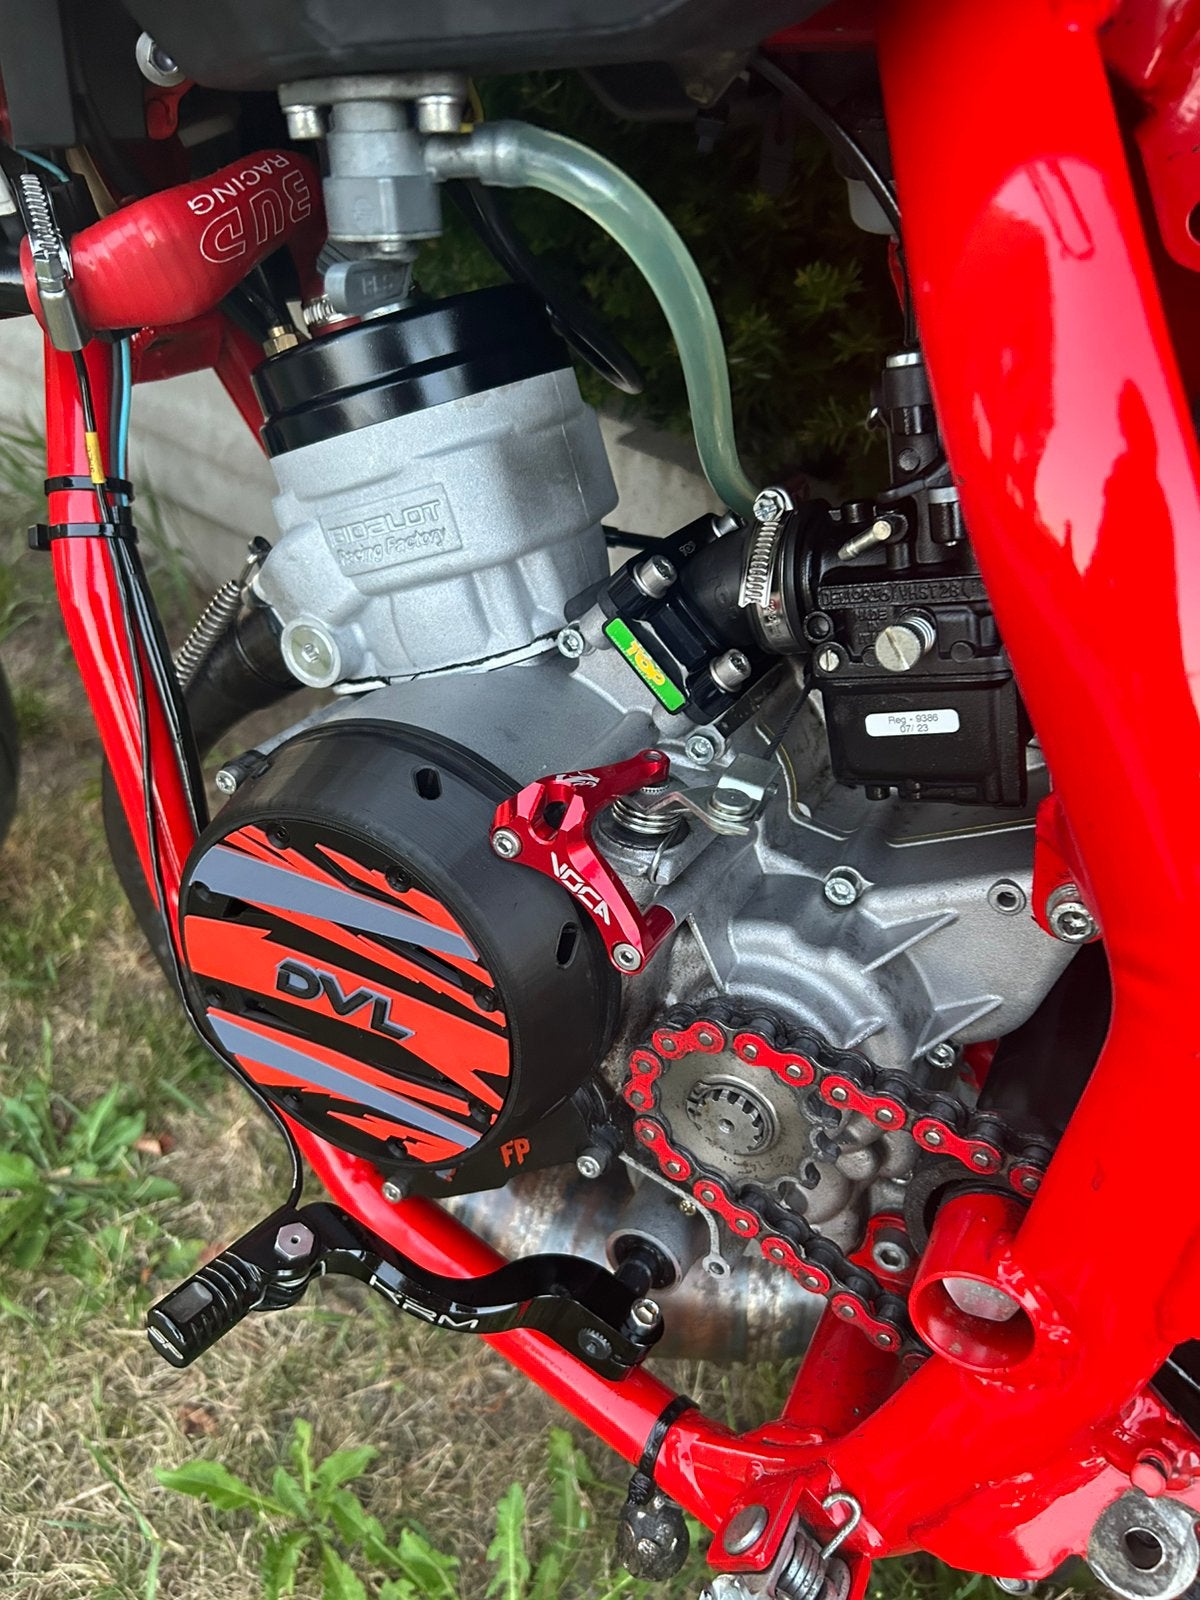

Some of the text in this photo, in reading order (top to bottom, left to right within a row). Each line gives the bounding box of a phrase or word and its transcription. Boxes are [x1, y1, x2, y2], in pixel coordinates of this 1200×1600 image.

[187, 154, 290, 215] RACING
[200, 169, 311, 263] BUD
[385, 526, 446, 554] Factory
[626, 639, 666, 686] TOP
[888, 715, 907, 725] Reg
[551, 851, 611, 926] VOCA
[275, 956, 416, 1041] DVL
[500, 1138, 530, 1168] FP
